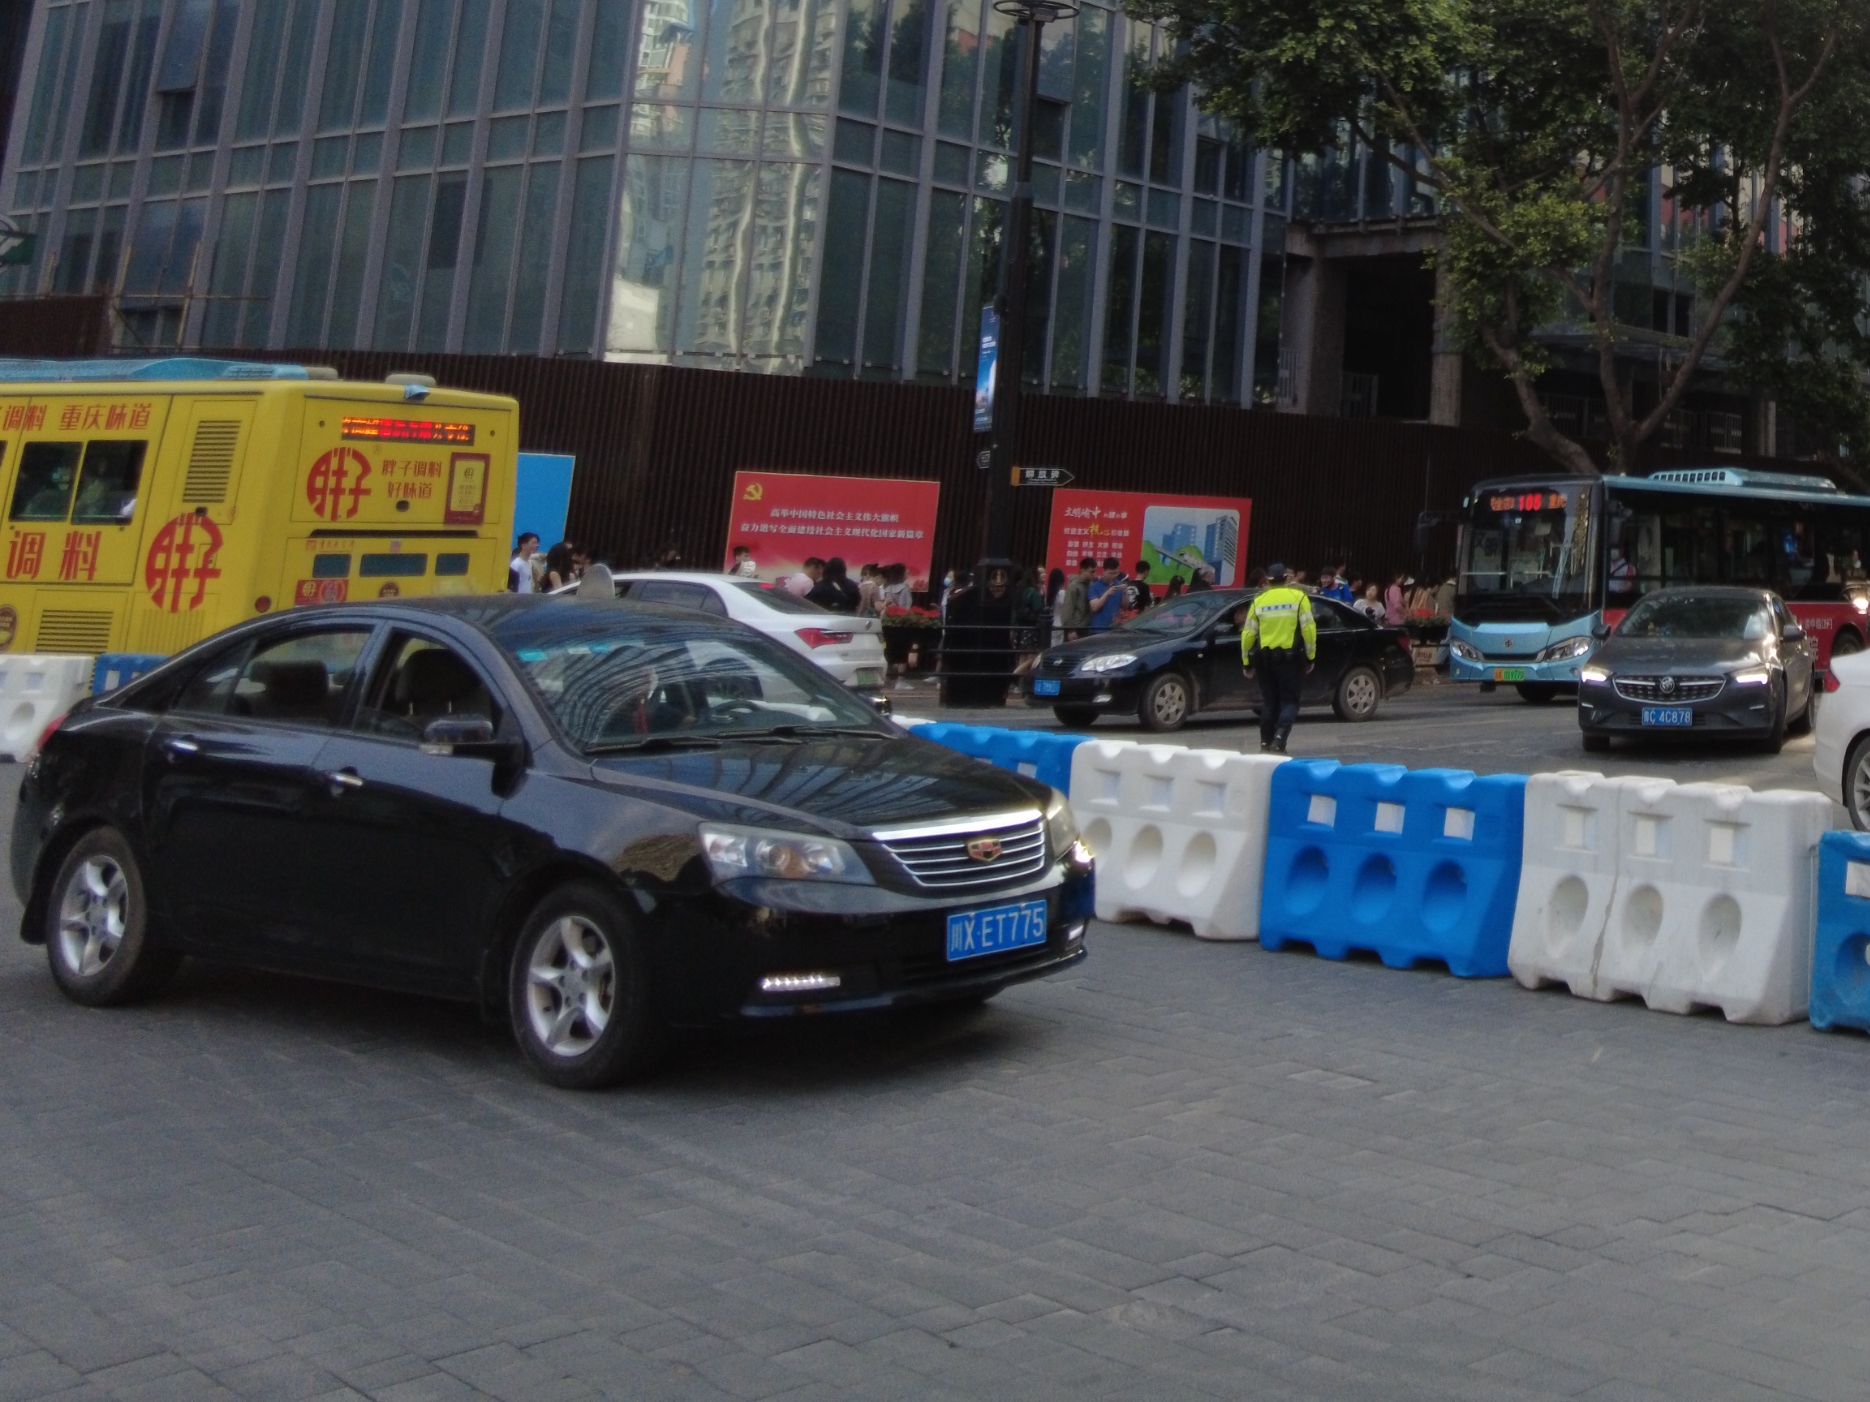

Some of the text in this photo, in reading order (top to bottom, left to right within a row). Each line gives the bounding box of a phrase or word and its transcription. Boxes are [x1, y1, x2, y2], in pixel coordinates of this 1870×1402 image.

[0, 402, 152, 431] 调料 重庆味道
[387, 481, 432, 500] 好味道
[6, 530, 102, 581] 调料
